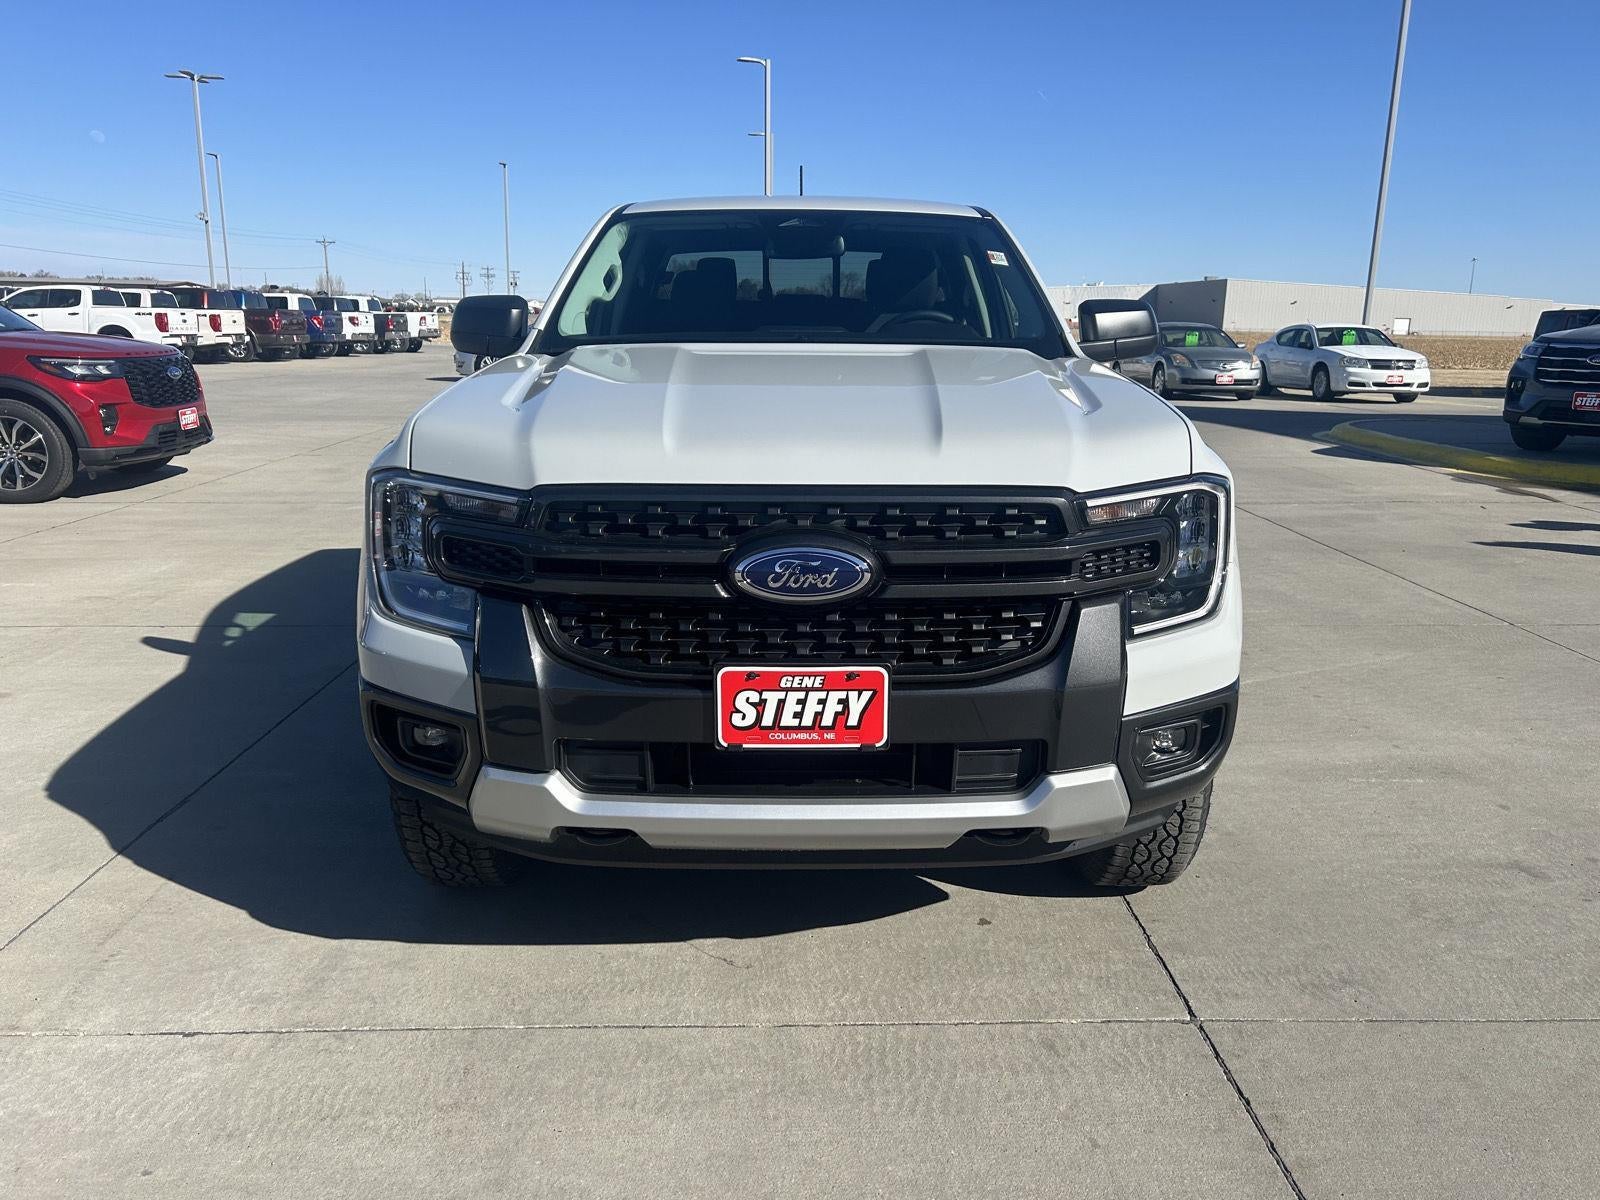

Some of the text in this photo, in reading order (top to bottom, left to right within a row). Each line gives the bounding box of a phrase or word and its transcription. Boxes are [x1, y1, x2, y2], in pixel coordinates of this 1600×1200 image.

[767, 559, 839, 588] Ford
[779, 675, 825, 688] GENE
[730, 689, 877, 729] STEFFY
[769, 732, 836, 741] COLUMBUS, NE
